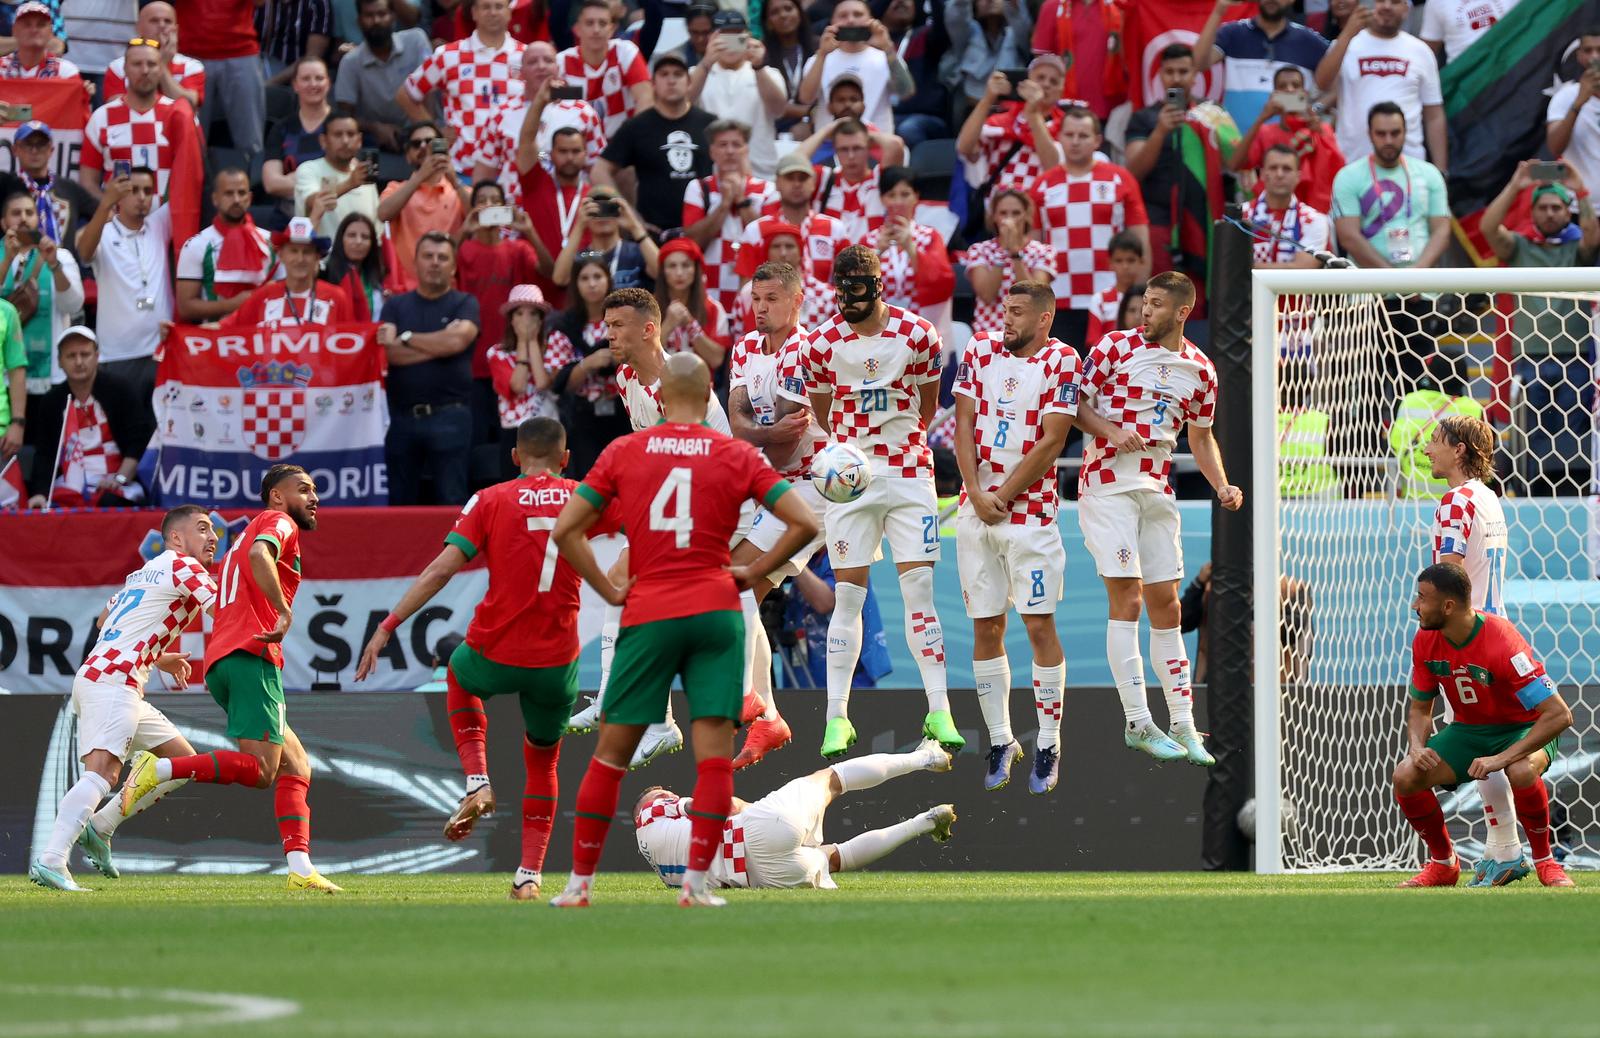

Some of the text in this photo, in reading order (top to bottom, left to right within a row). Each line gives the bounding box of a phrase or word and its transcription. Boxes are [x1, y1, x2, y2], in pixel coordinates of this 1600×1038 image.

[184, 332, 365, 357] PRIMO
[860, 388, 888, 413] 20
[1152, 401, 1169, 425] 9
[645, 436, 713, 456] AMRABAT
[993, 420, 1010, 449] 8
[159, 463, 389, 500] MEĐUORJE
[518, 488, 571, 506] ZIYECH
[650, 467, 694, 549] 4
[526, 517, 558, 593] 7
[1031, 570, 1045, 598] 8
[1455, 676, 1479, 704] 6
